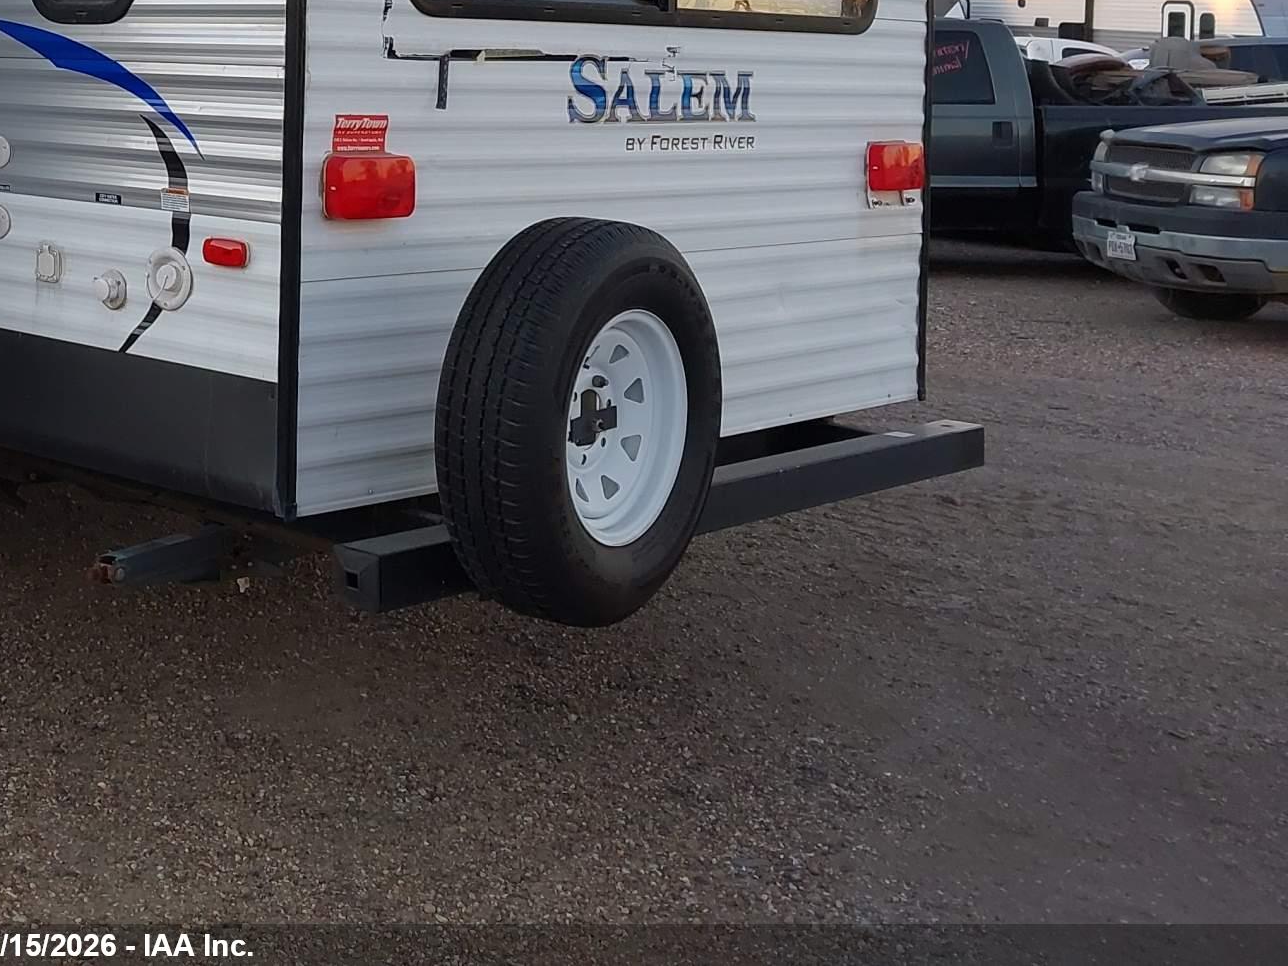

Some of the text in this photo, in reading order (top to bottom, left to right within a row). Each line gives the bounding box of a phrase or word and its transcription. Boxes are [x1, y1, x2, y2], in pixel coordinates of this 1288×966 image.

[567, 54, 757, 124] SALEM
[336, 117, 387, 130] TerryTown
[626, 134, 755, 151] BY FOREST RIVER
